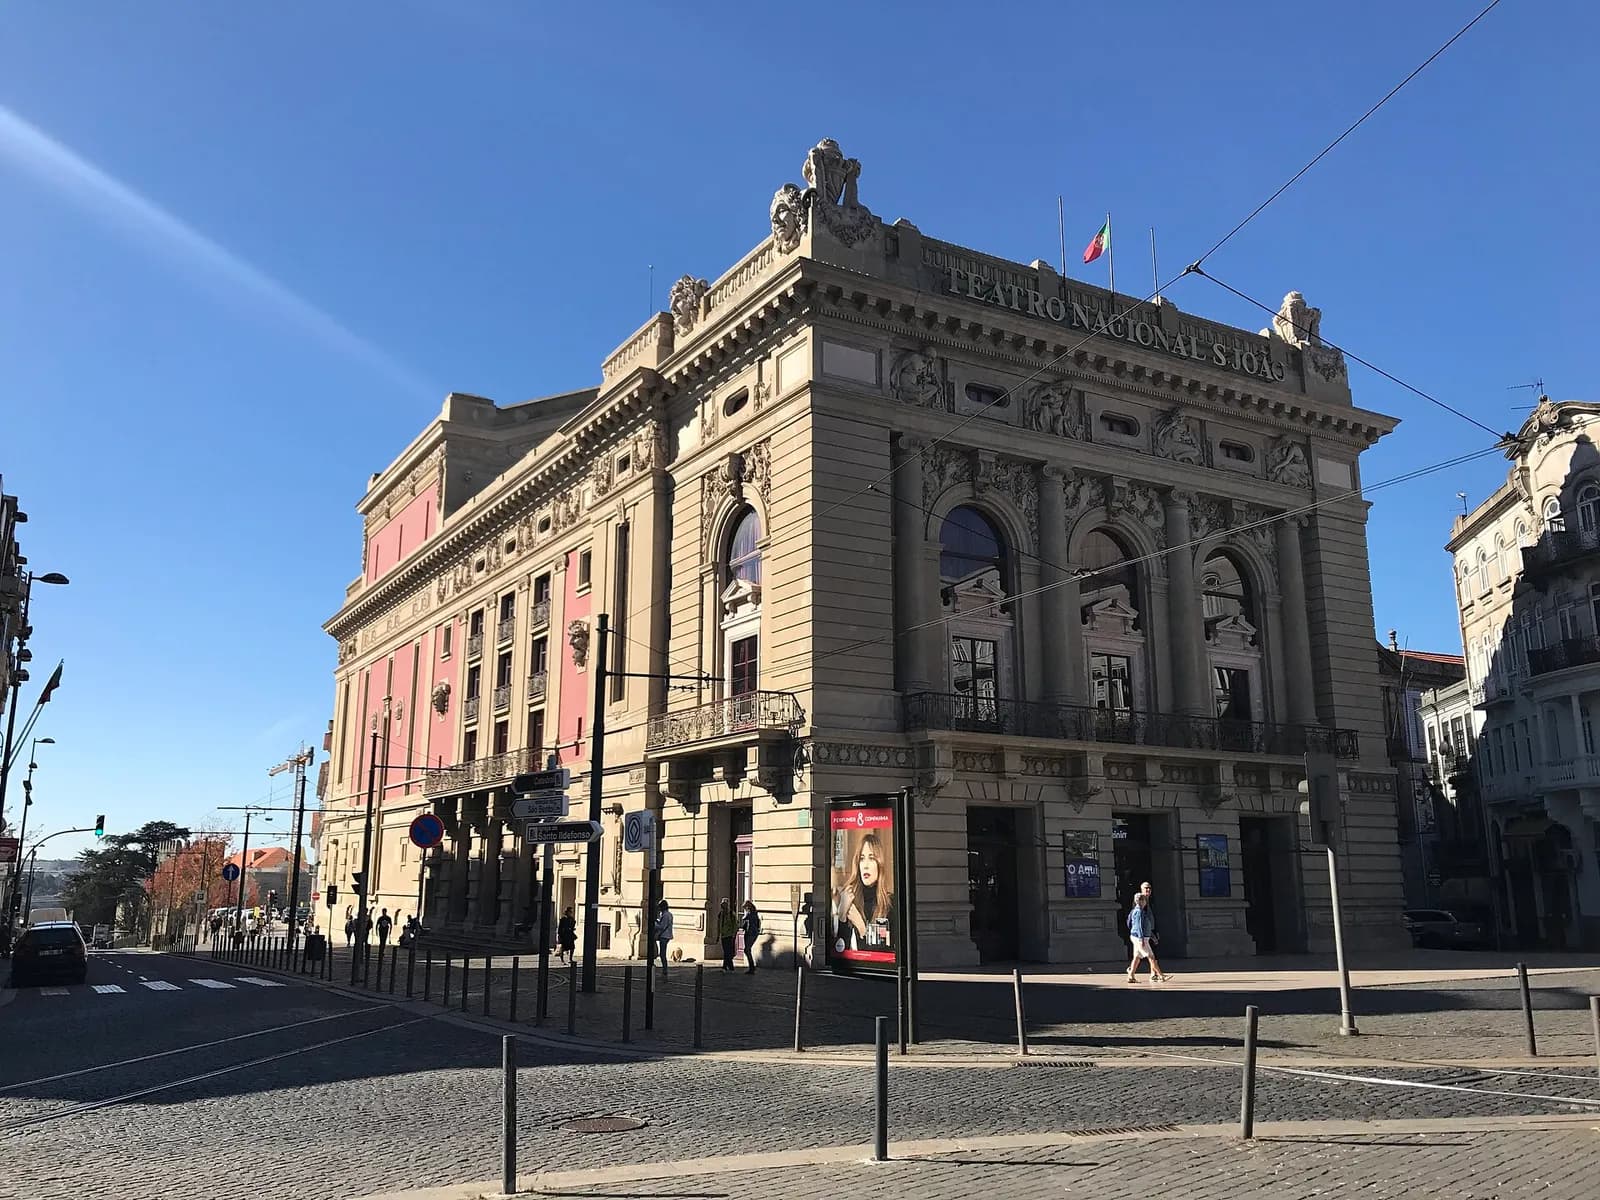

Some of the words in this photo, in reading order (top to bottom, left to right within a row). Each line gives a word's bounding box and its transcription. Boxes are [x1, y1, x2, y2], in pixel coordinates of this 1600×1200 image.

[945, 266, 1066, 322] TEATRO
[1071, 302, 1207, 361] NACIONAL
[538, 832, 558, 841] Santo
[558, 831, 590, 840] Ildefonso
